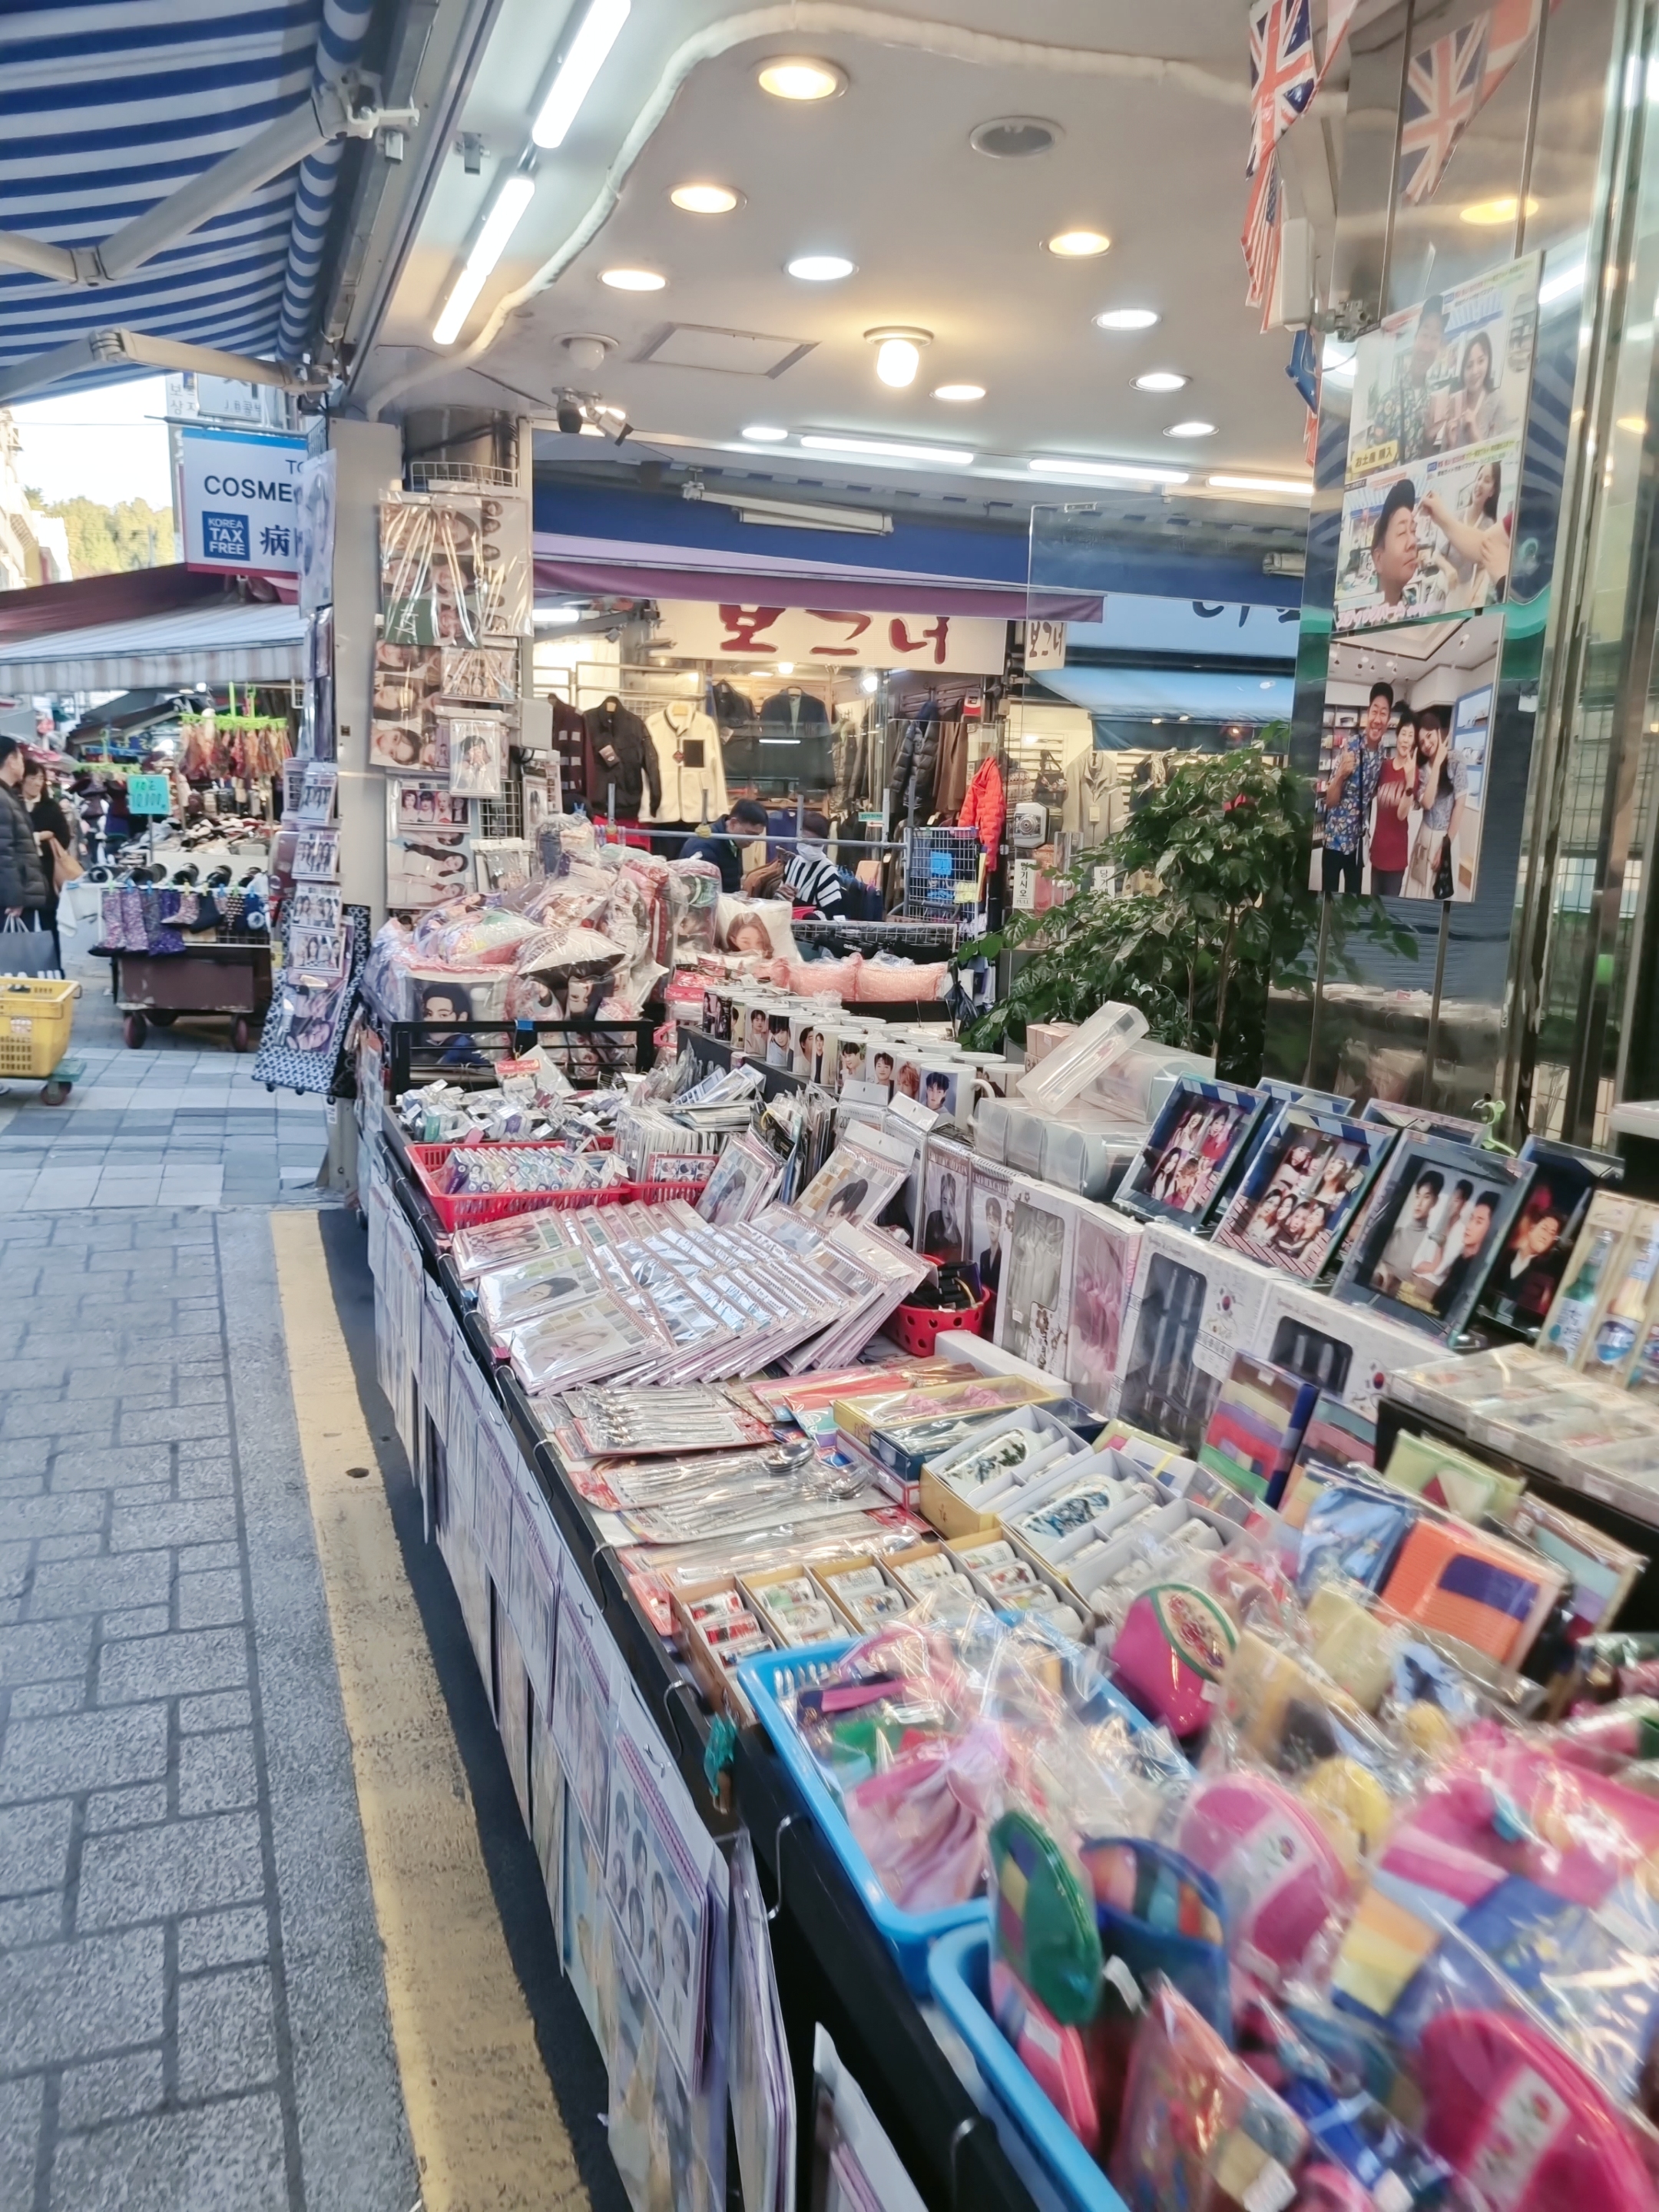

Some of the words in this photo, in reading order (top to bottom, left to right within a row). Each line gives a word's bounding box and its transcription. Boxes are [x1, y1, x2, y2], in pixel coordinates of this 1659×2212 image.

[204, 475, 295, 503] COSME
[208, 518, 244, 529] KOREA
[209, 527, 243, 543] TAX
[260, 525, 298, 557] 病
[209, 541, 245, 555] FREE
[843, 943, 862, 952] adidas
